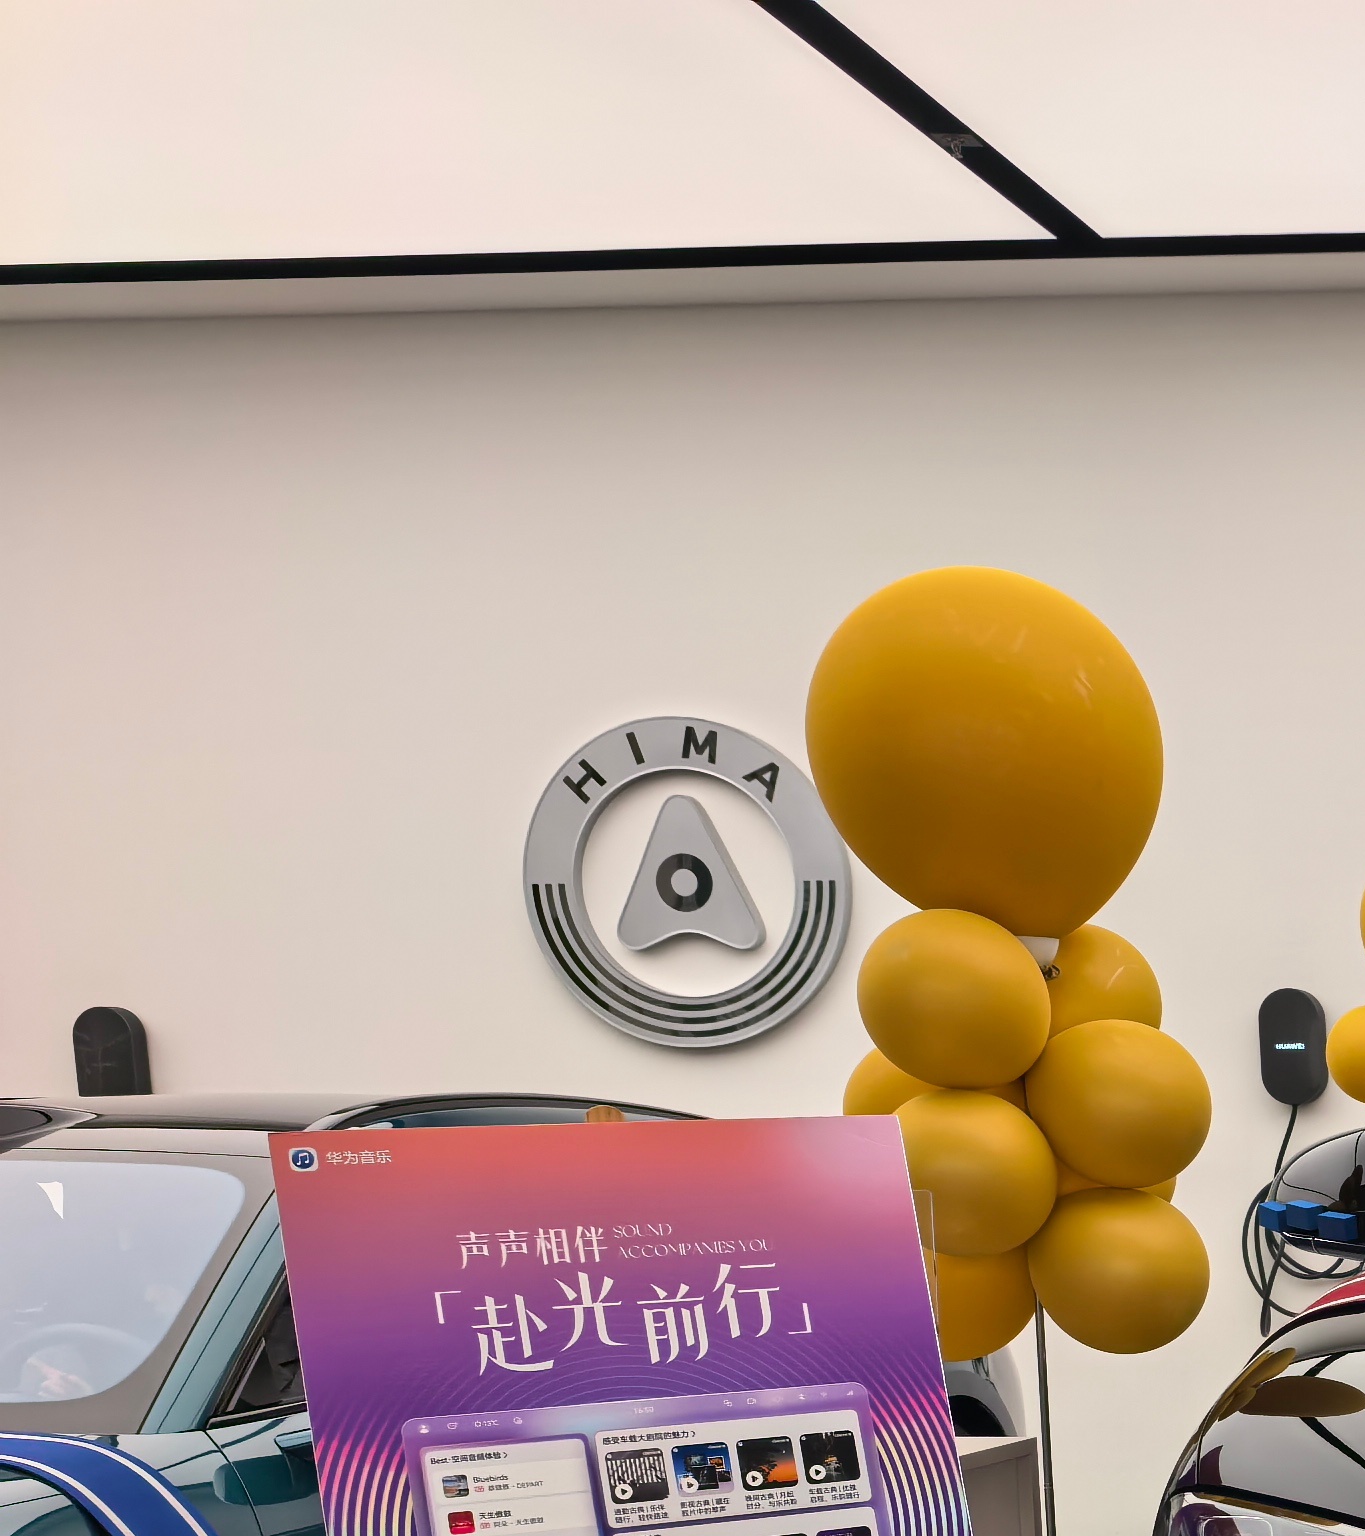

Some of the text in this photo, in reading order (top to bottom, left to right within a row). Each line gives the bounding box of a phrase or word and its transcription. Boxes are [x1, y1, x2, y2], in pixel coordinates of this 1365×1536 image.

[563, 726, 780, 804] HIMA
[325, 1149, 392, 1166] 华为音乐
[613, 1223, 672, 1239] SOUND
[456, 1225, 609, 1269] 声声相伴
